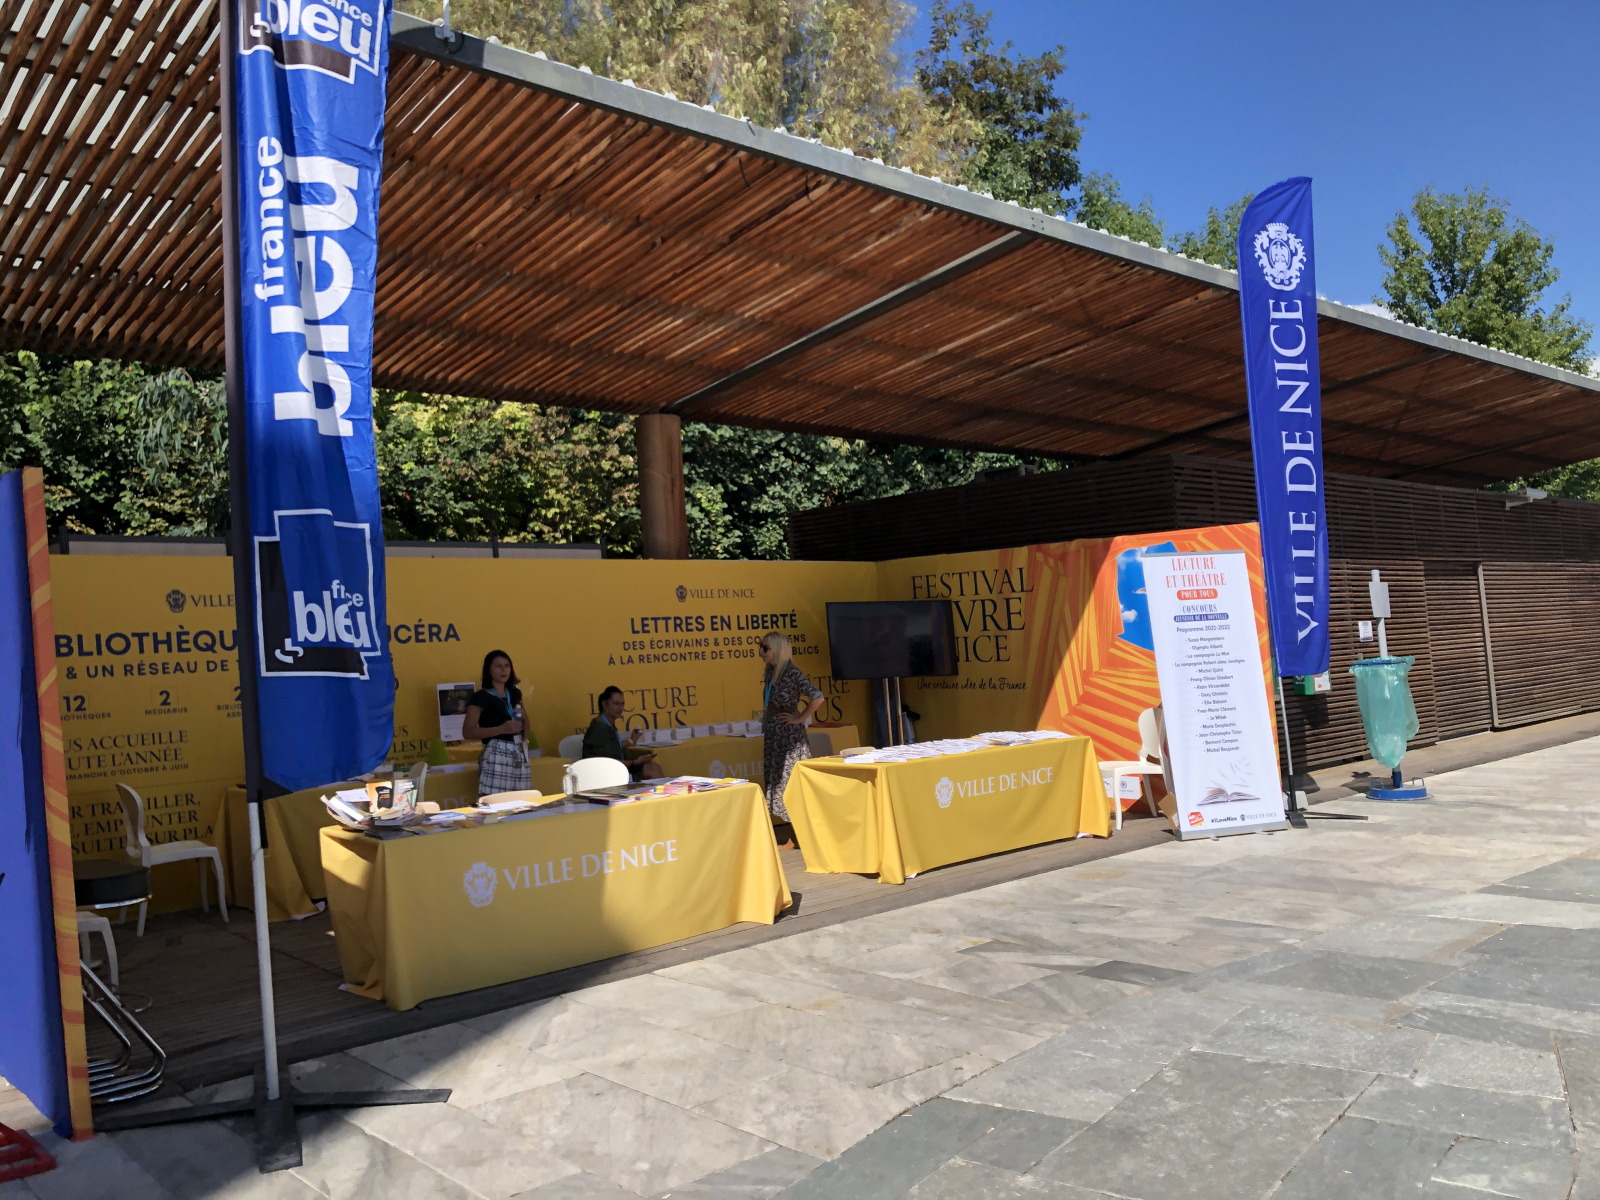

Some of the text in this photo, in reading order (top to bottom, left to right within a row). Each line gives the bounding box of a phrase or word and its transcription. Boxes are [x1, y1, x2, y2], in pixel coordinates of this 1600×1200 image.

[254, 136, 285, 302] france
[270, 155, 359, 437] bleu
[1268, 299, 1313, 418] NICE
[1281, 430, 1317, 496] DE
[1171, 557, 1216, 571] LECTURE
[911, 567, 1034, 599] FESTIVAL
[1166, 571, 1226, 588] ET THÉÂTRE
[1288, 510, 1319, 645] VILLE
[190, 594, 235, 607] VILLE
[690, 588, 755, 599] VILLE DE NICE
[1181, 589, 1215, 599] POUR TOUS
[1182, 603, 1217, 614] CONCOURS
[630, 609, 798, 635] LETTRES EN LIBERTÉ
[623, 641, 646, 651] DES
[650, 637, 710, 650] ÉCRIVAINS
[713, 638, 720, 647] &
[723, 636, 743, 646] DES
[608, 653, 616, 665] À
[619, 655, 635, 665] LA
[638, 650, 707, 664] RENCONTRE
[711, 650, 724, 660] DE
[728, 648, 756, 659] TOUS
[66, 666, 78, 680] &
[86, 664, 114, 679] UN
[123, 659, 198, 677] RÉSEAU
[206, 659, 230, 672] DE
[917, 678, 930, 689] Une
[978, 678, 987, 689] de
[989, 677, 997, 689] la
[998, 677, 1027, 690] France
[62, 695, 87, 712] 12
[158, 690, 171, 706] 2
[87, 730, 189, 750] ACCUEILLE
[112, 746, 184, 767] L'ANNÉE
[110, 766, 160, 777] D'OCTOBRE
[170, 763, 189, 771] JUIN
[956, 766, 1053, 799] VILLE DE NICE
[501, 840, 678, 891] VILLE DE NICE
